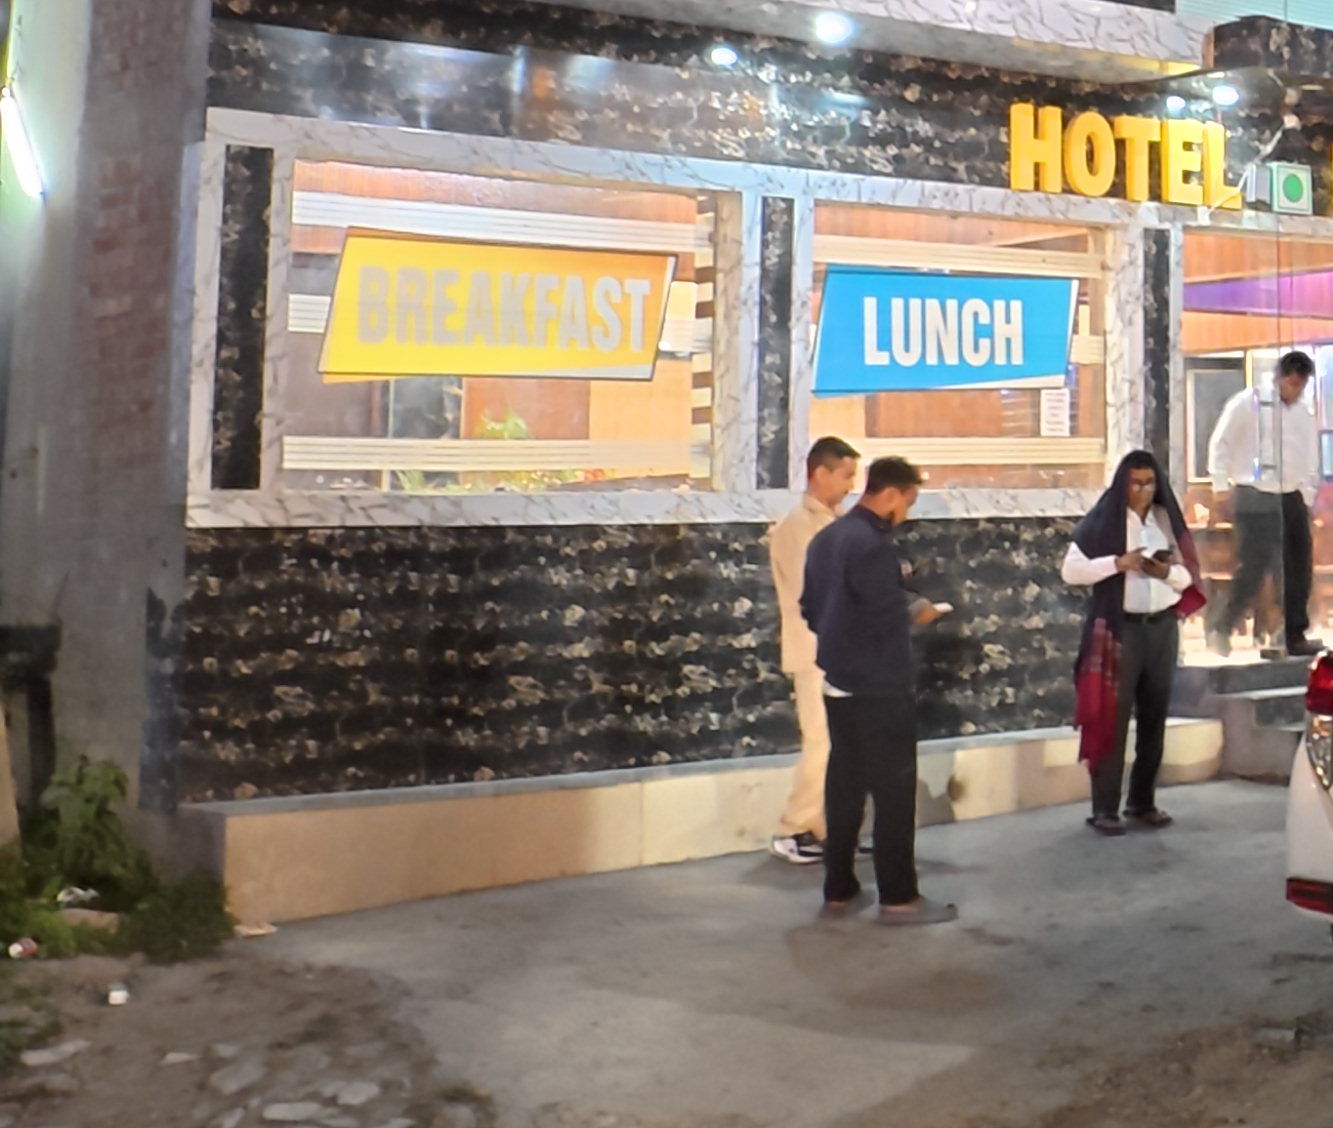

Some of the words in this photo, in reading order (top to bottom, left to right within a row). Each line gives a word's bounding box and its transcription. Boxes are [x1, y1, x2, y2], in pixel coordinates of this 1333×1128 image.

[1010, 102, 1242, 210] HOTEL
[356, 265, 652, 352] BREAKFAST
[863, 296, 1024, 368] LUNCH
